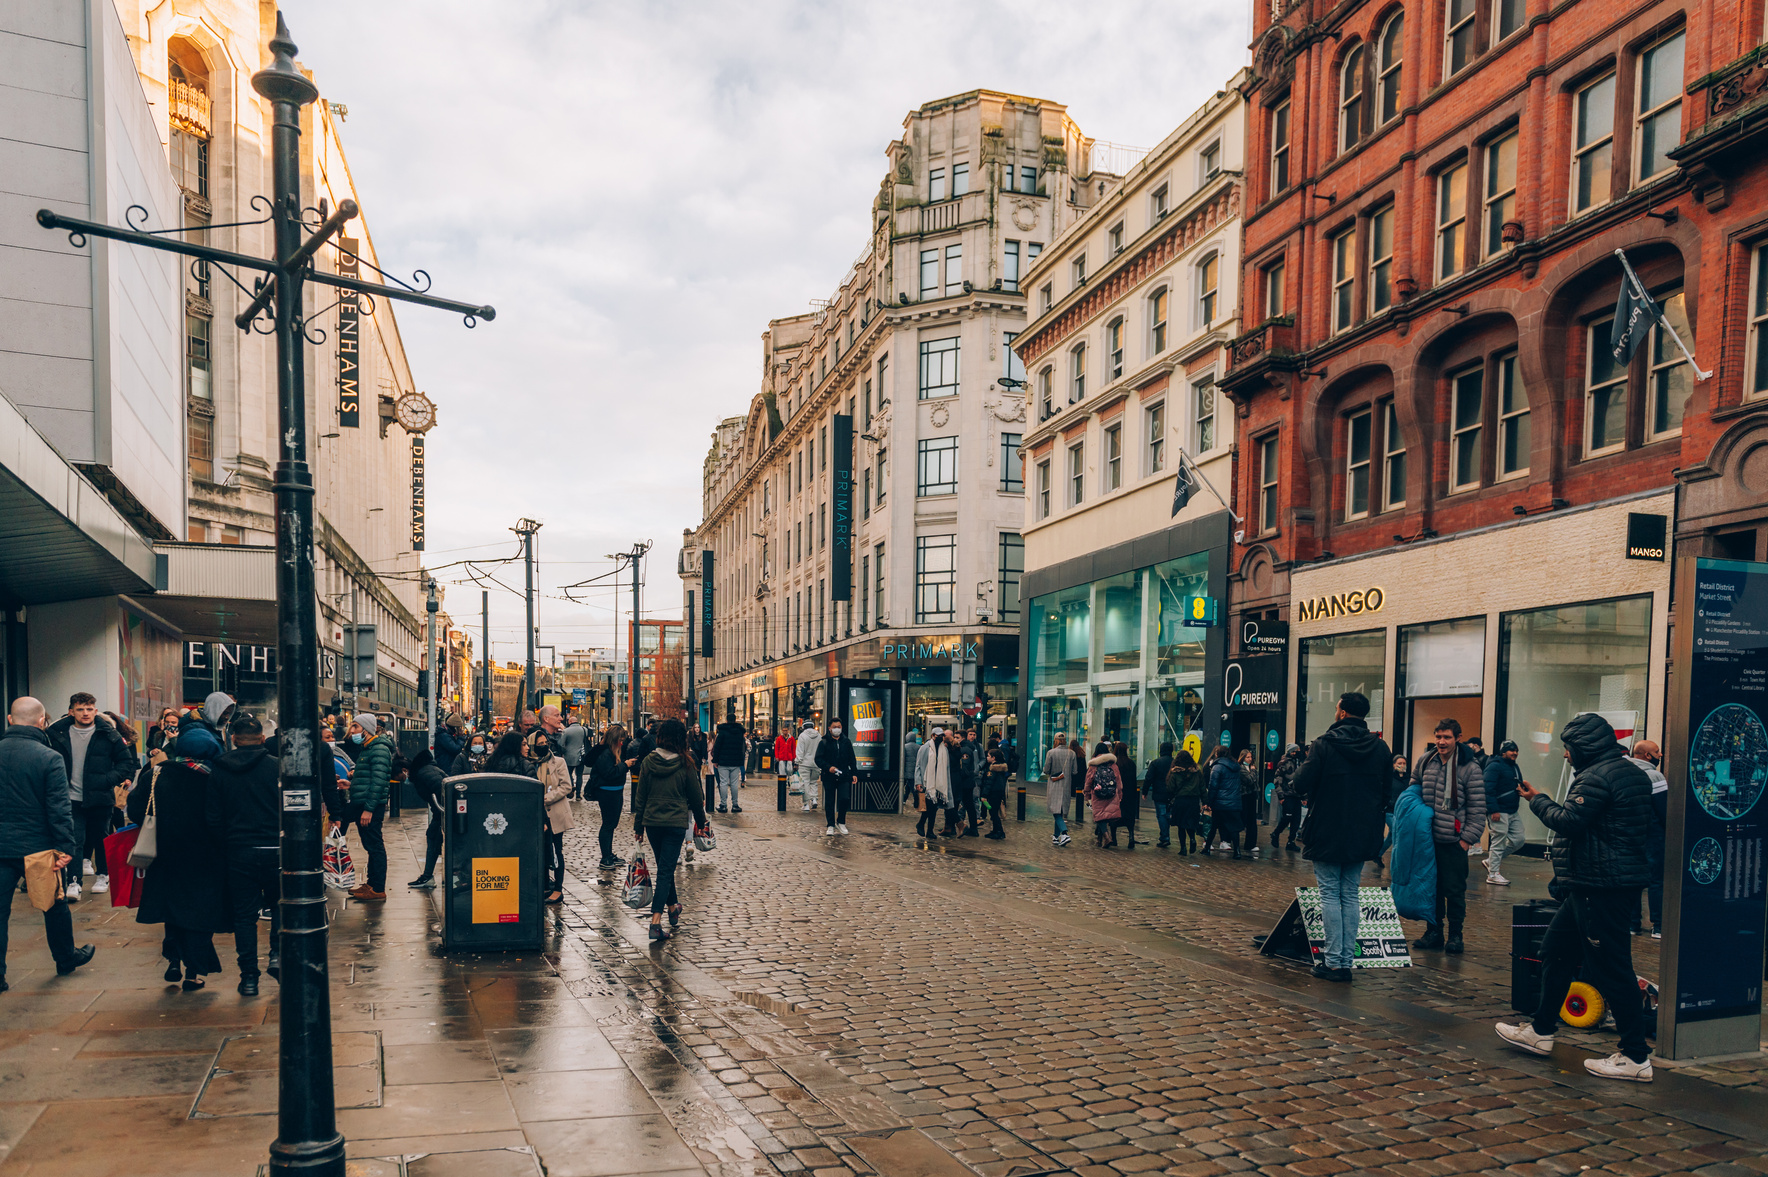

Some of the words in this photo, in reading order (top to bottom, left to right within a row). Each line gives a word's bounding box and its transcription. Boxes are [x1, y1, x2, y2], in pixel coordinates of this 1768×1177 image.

[341, 254, 358, 412] DEBENHAMS
[413, 446, 424, 543] DEBENHAMS
[837, 470, 848, 546] PRIMARK
[1631, 547, 1663, 558] MANGO
[1700, 582, 1715, 590] Retail
[1716, 583, 1735, 591] District
[1699, 592, 1716, 601] Market
[1717, 593, 1732, 602] Street
[1299, 587, 1384, 623] MANGO
[883, 642, 978, 660] PRIMARK
[1241, 692, 1278, 705] PUREGYM
[857, 702, 877, 719] BIN
[861, 719, 878, 729] YOUR
[1361, 906, 1398, 921] Man
[1361, 946, 1383, 957] Spotify
